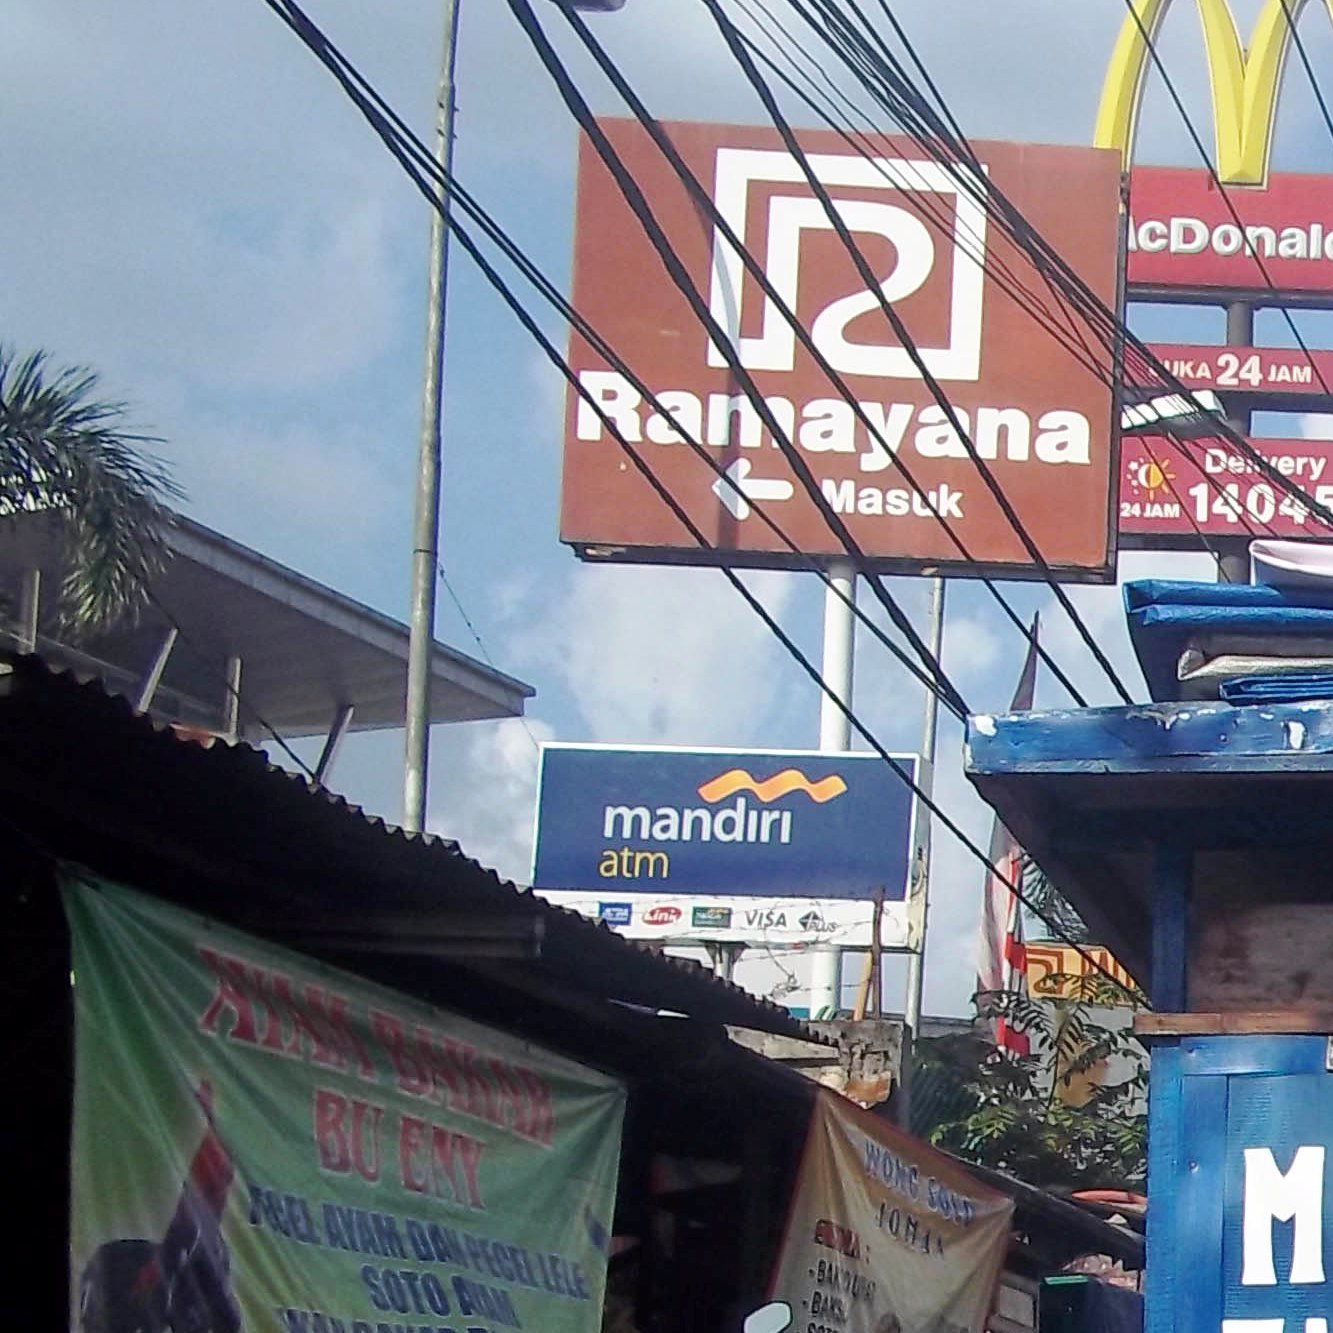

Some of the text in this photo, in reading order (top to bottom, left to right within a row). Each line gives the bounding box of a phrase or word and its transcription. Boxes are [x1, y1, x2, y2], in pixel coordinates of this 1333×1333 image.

[1151, 353, 1313, 387] UKA 24 JAM
[576, 369, 1092, 472] Ramayana
[818, 478, 965, 519] Masuk
[1119, 501, 1180, 519] 24 JAM
[602, 796, 793, 844] mandiri
[598, 846, 669, 879] atm
[744, 909, 787, 928] VISA
[313, 1086, 385, 1187] BU
[361, 1263, 451, 1317] SOTO
